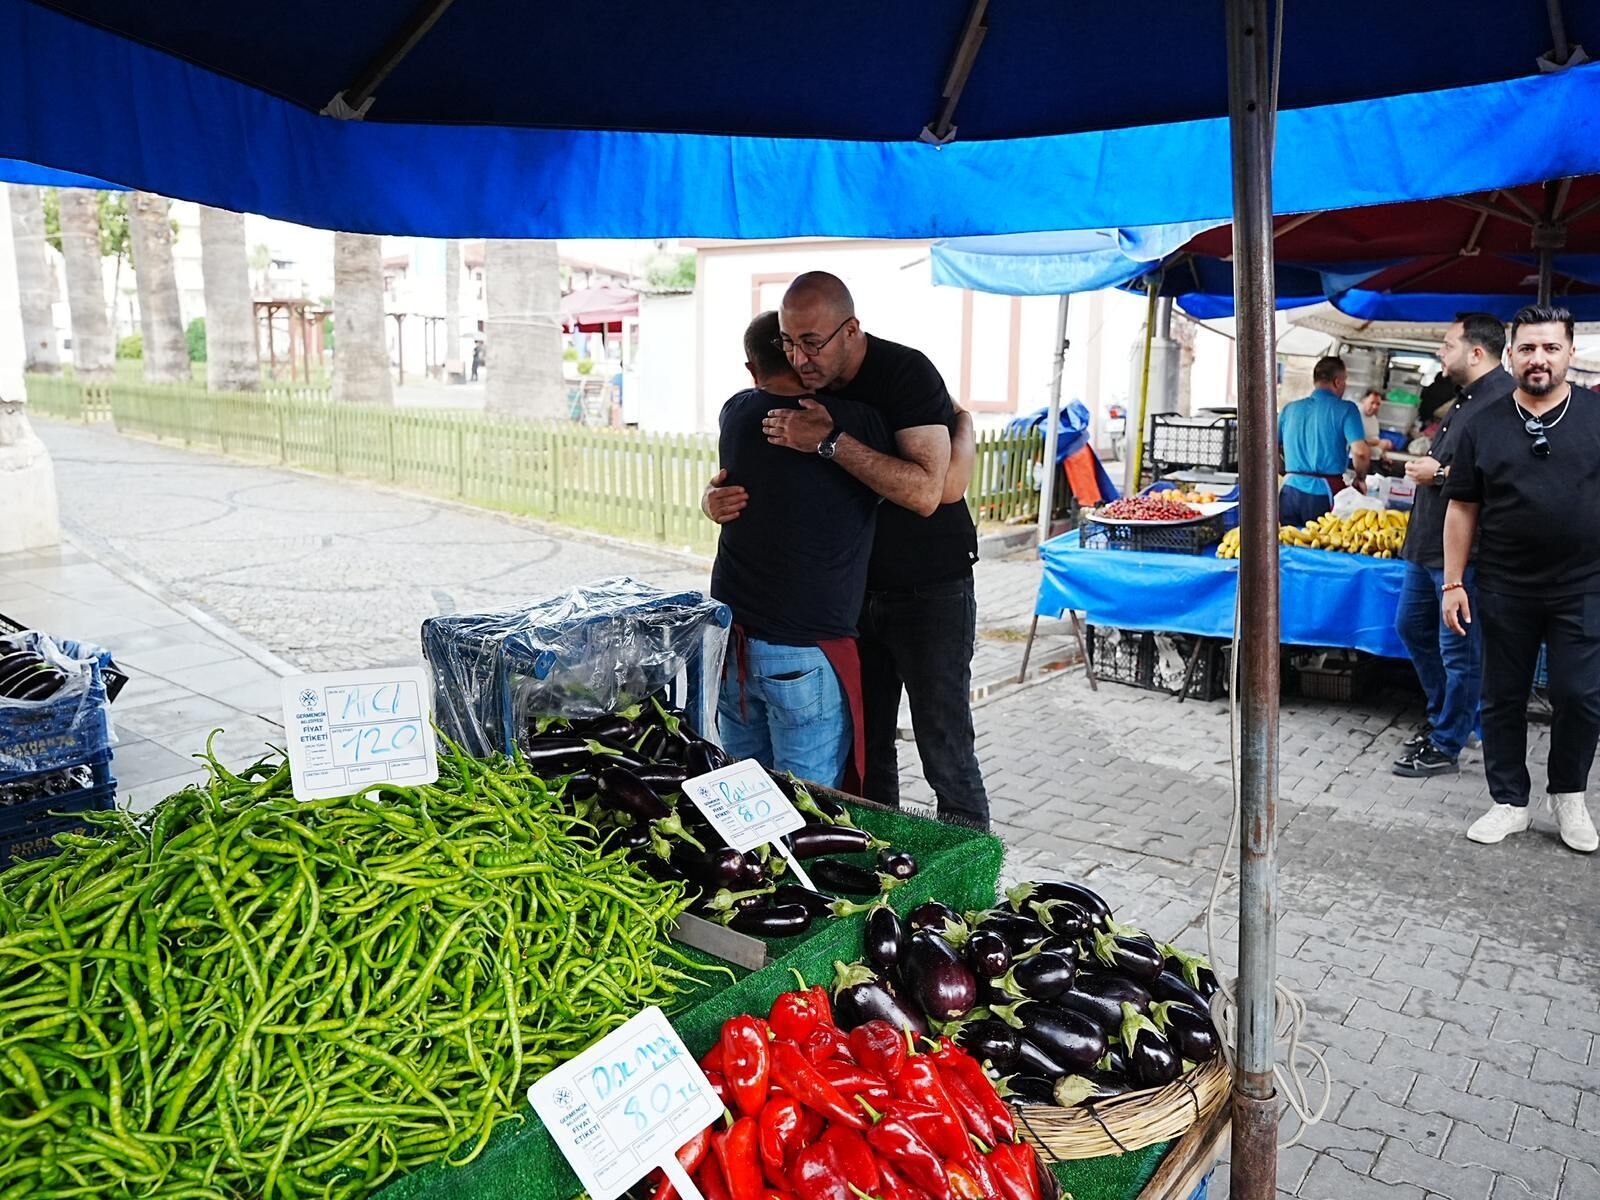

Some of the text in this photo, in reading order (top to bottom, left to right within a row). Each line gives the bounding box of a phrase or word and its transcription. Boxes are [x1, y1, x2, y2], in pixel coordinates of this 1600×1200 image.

[300, 732, 329, 742] ETİKETİ
[303, 725, 323, 733] FİYAT
[342, 725, 418, 761] 120
[738, 799, 771, 822] 80
[624, 1083, 671, 1131] 80
[574, 1122, 601, 1145] ETİKETİ
